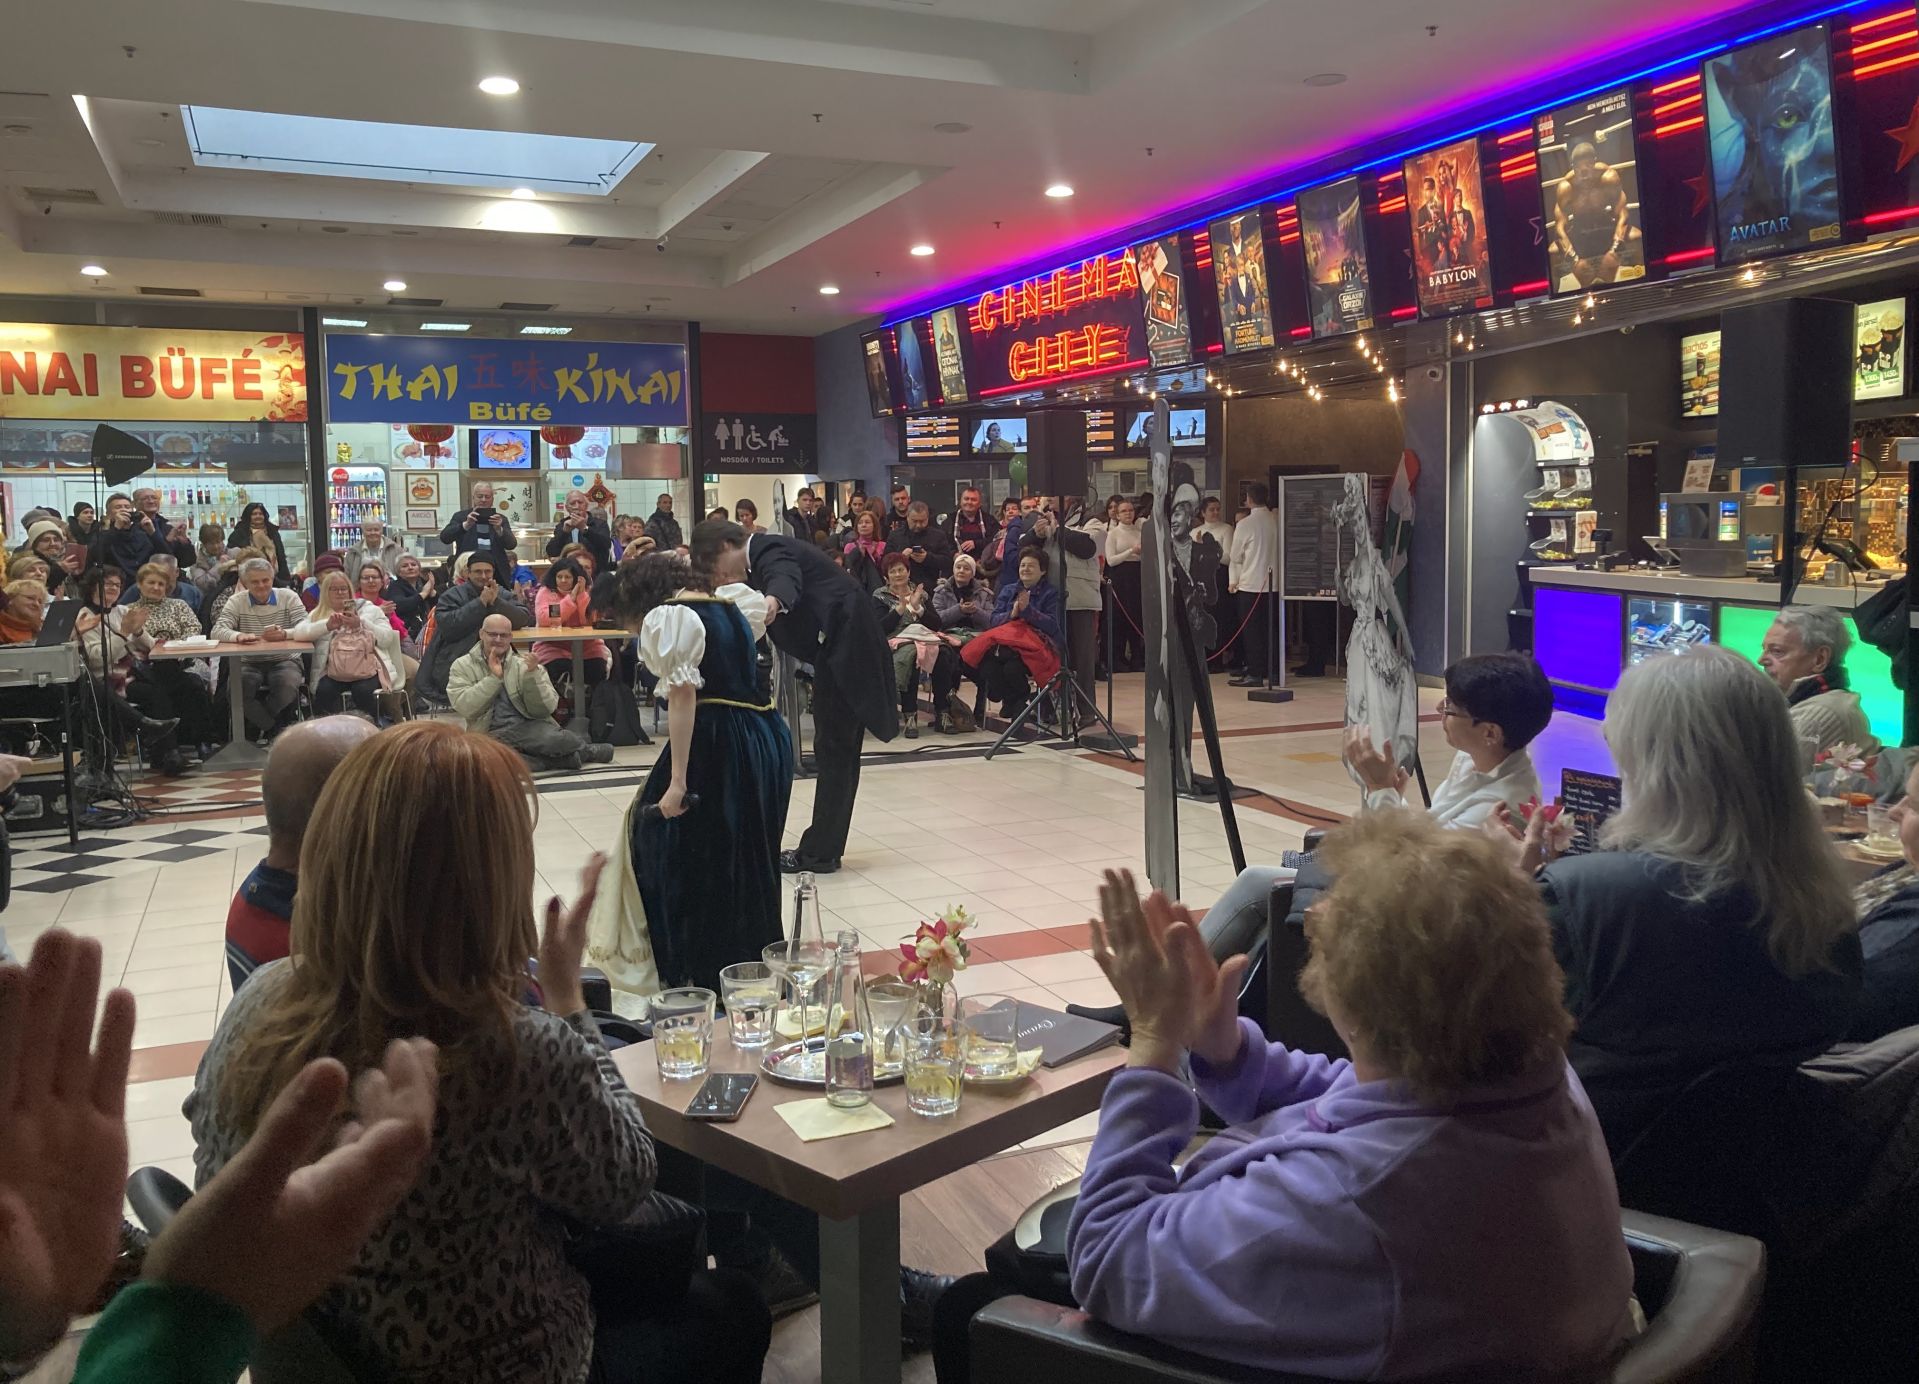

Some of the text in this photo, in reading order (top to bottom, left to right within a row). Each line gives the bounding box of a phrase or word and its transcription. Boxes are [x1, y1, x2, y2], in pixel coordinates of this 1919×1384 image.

[1730, 216, 1791, 241] AVATAR
[978, 247, 1138, 330] CINEMA
[1429, 267, 1477, 287] BABYLON
[1009, 323, 1100, 381] CITY
[0, 347, 264, 400] NAI BÜFÉ
[333, 352, 681, 406] THAI KÍNAI
[469, 401, 552, 422] Büfé
[757, 456, 784, 464] TOILETS
